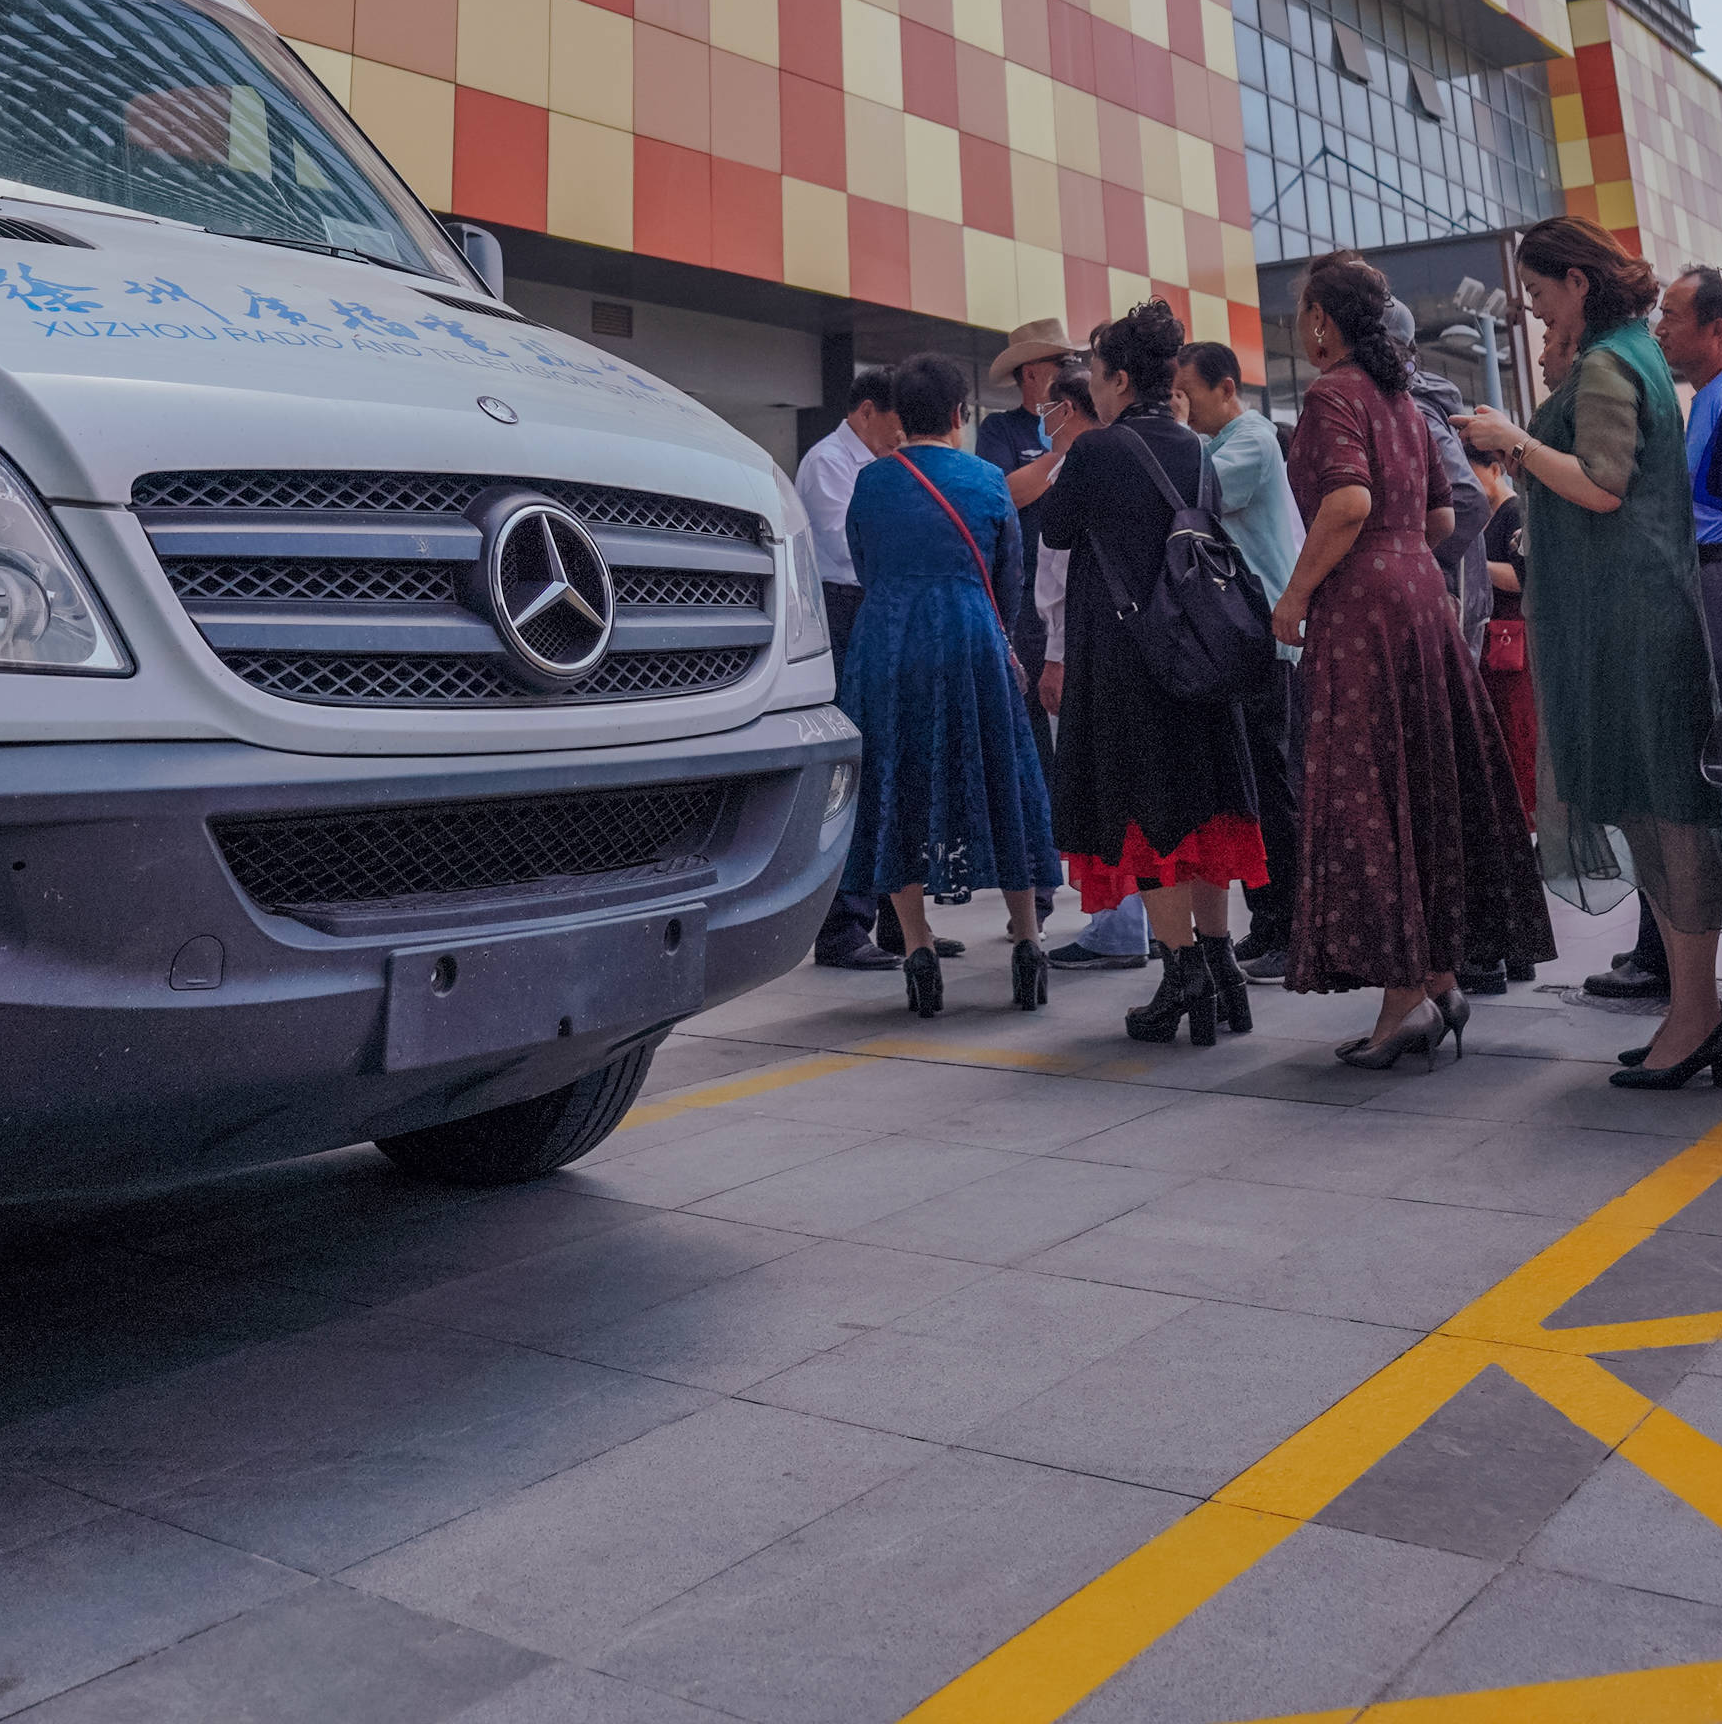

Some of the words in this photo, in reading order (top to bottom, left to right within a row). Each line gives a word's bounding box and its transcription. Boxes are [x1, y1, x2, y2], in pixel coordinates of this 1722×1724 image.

[32, 320, 217, 341] XUZHOU
[222, 326, 344, 349] RADIO
[353, 337, 422, 358] AND
